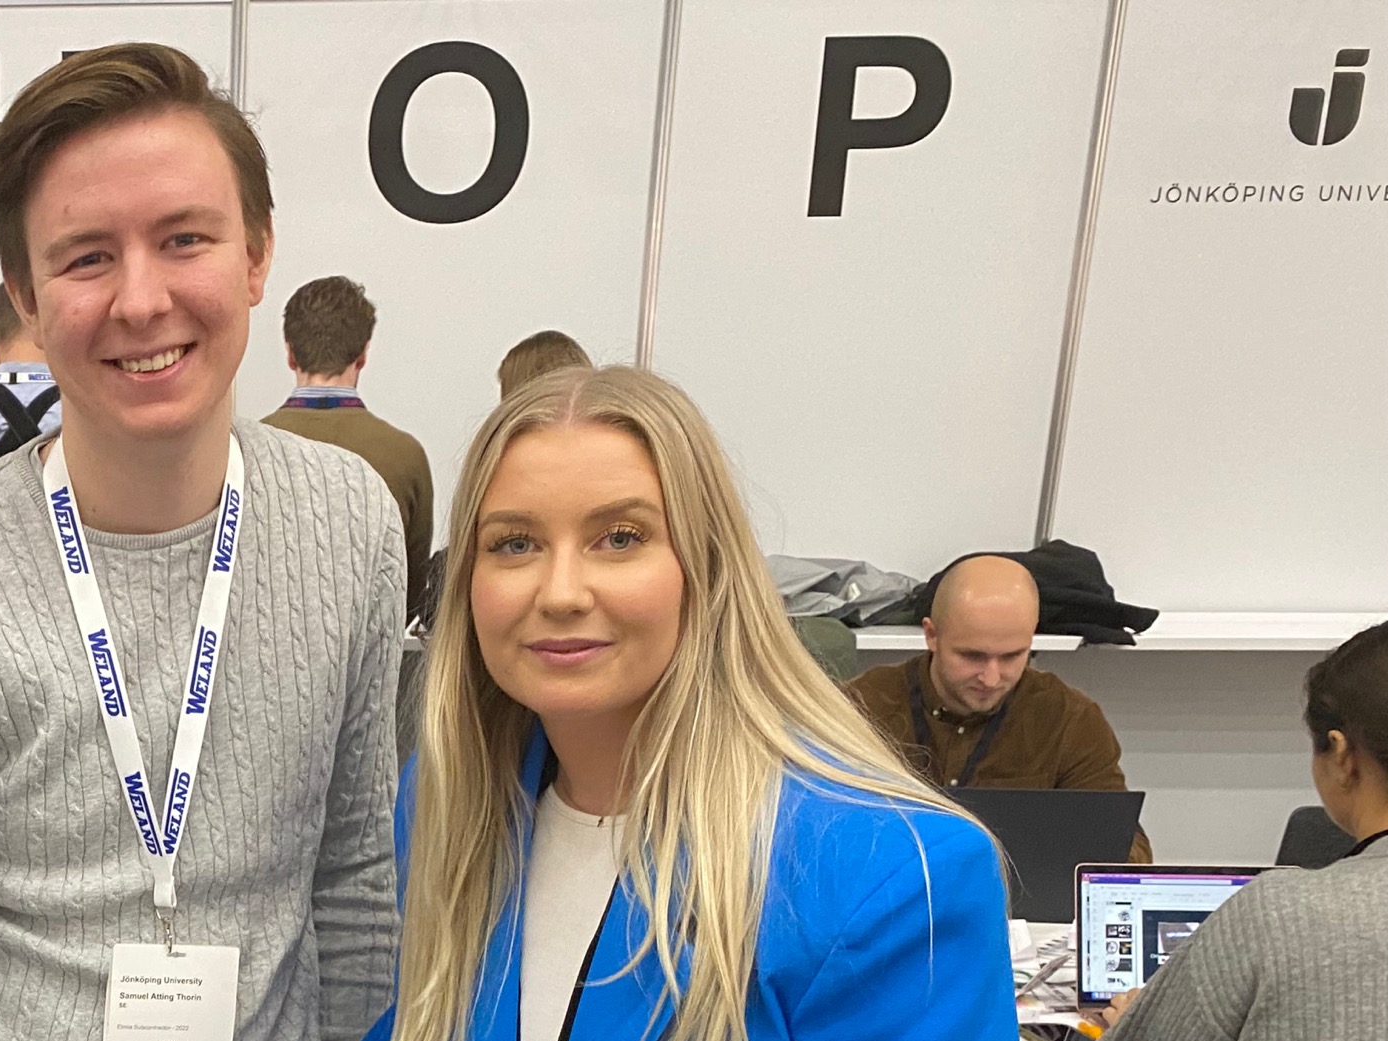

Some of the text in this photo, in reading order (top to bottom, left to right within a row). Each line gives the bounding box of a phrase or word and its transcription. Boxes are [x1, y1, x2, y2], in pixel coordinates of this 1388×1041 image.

[368, 40, 530, 225] O
[807, 36, 953, 218] P
[1150, 182, 1304, 203] JÖNKÖPING
[50, 487, 86, 575] WELAND
[212, 487, 240, 573] WELAND
[88, 628, 123, 717] WELAND
[185, 629, 217, 715] WELAND
[124, 771, 159, 857] WELAND
[162, 771, 191, 856] WELAND
[119, 992, 149, 1000] Samuel
[176, 993, 202, 1001] Thorin
[120, 976, 203, 986] Jönköping University
